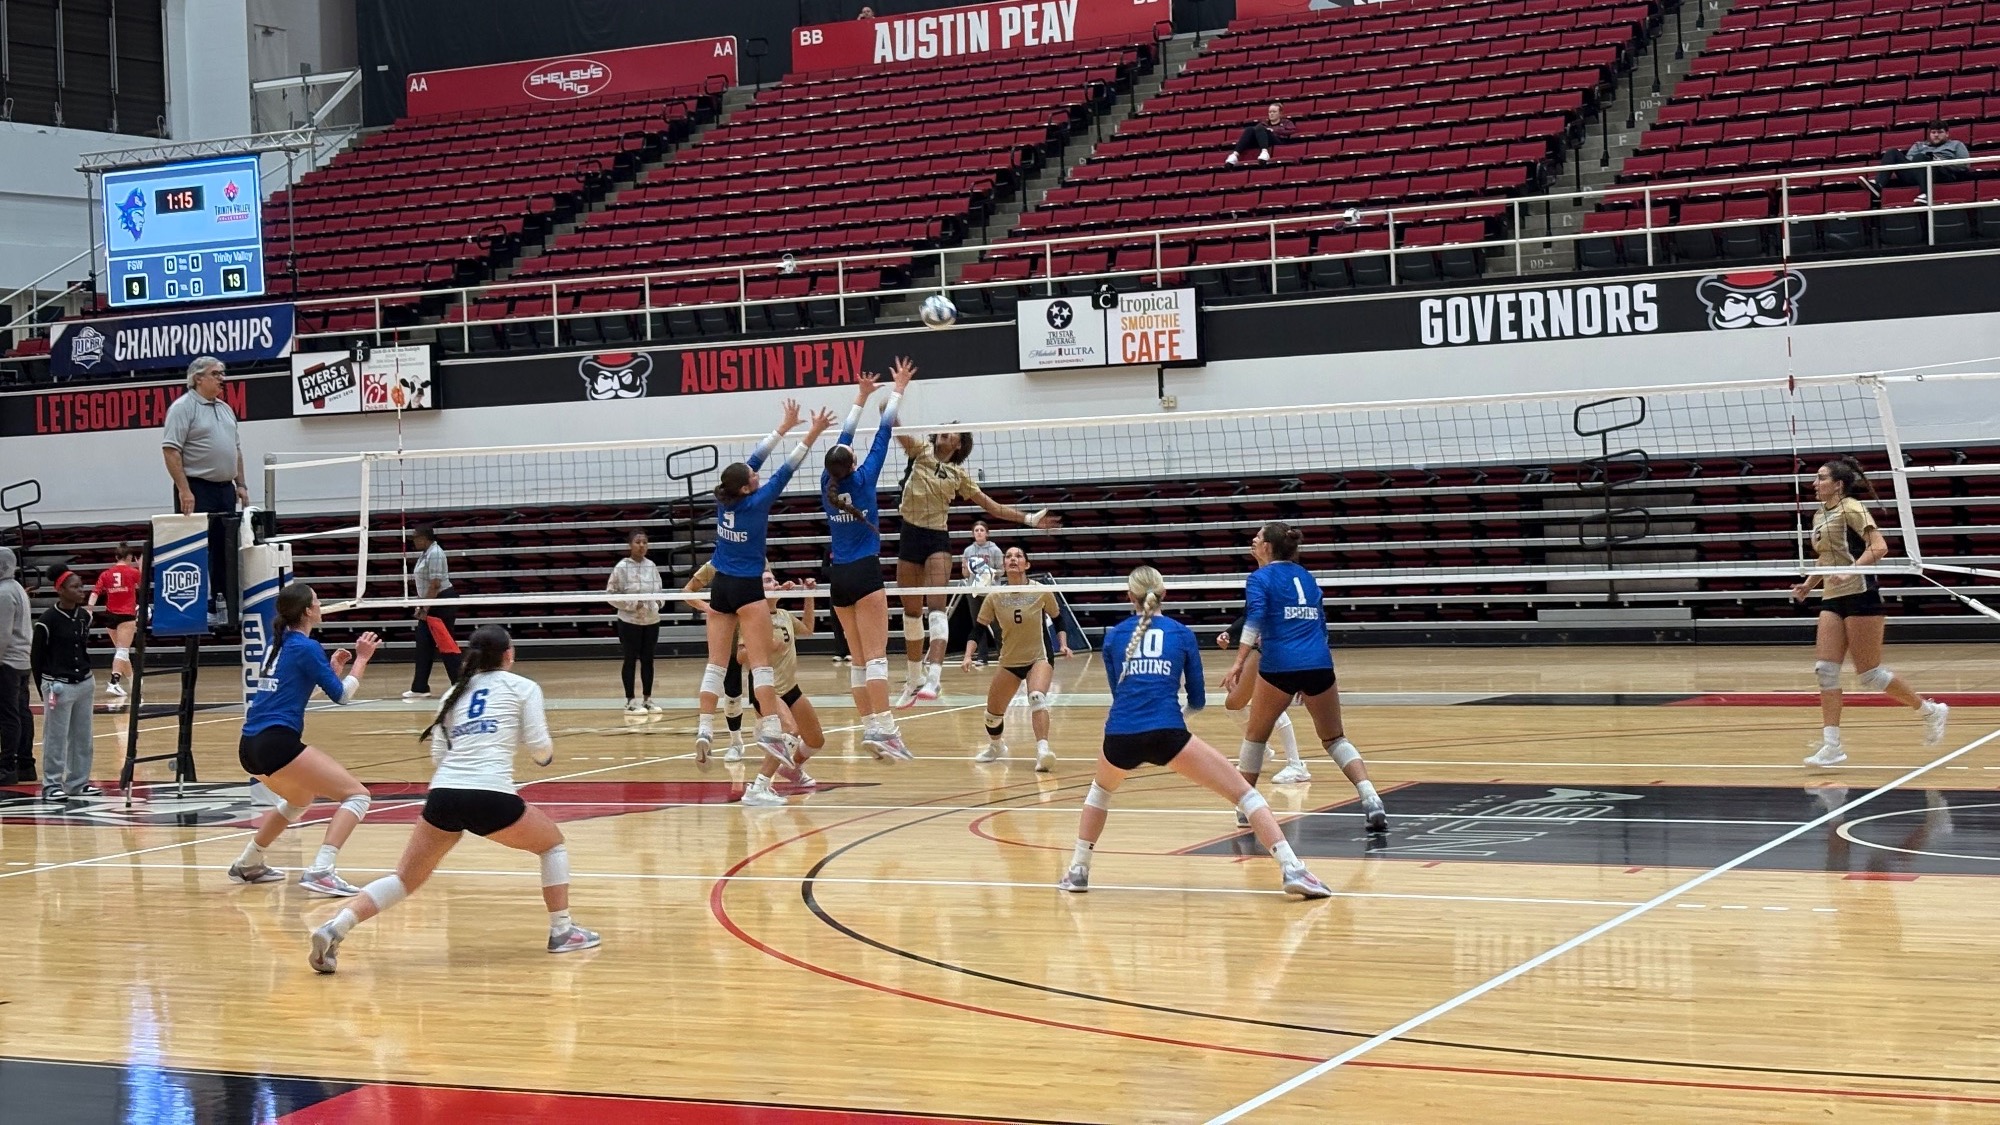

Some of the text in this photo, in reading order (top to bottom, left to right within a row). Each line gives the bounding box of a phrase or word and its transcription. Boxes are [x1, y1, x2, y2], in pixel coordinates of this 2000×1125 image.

[800, 30, 823, 46] BB
[874, 0, 1078, 64] AUSTIN PEAY
[714, 41, 732, 57] AA
[530, 64, 603, 86] SHELBY'S
[410, 78, 428, 92] AA
[557, 80, 589, 94] TRIO
[167, 191, 193, 210] 1:15
[127, 260, 143, 271] FSW
[168, 260, 174, 270] 0
[193, 258, 197, 267] 1
[213, 251, 253, 264] Trinity Valley
[132, 281, 140, 296] 9
[227, 273, 241, 288] 13
[1100, 294, 1111, 308] C
[1120, 292, 1179, 315] tropical
[1121, 313, 1180, 331] SMOOTHIE
[1420, 283, 1659, 346] GOVERNORS
[115, 316, 274, 361] CHAMPIONSHIPS
[1046, 336, 1076, 345] BEVERAGE
[1060, 330, 1074, 338] STAR
[1064, 347, 1095, 356] ULTRA
[1122, 329, 1182, 364] CAFE
[356, 349, 364, 361] B
[681, 340, 865, 393] AUSTIN PEAY
[302, 366, 348, 389] BYERS &
[304, 374, 350, 401] HARVEY
[113, 573, 121, 587] 3
[164, 572, 200, 594] NJCAA
[1293, 577, 1307, 605] 1
[468, 688, 489, 719] 6
